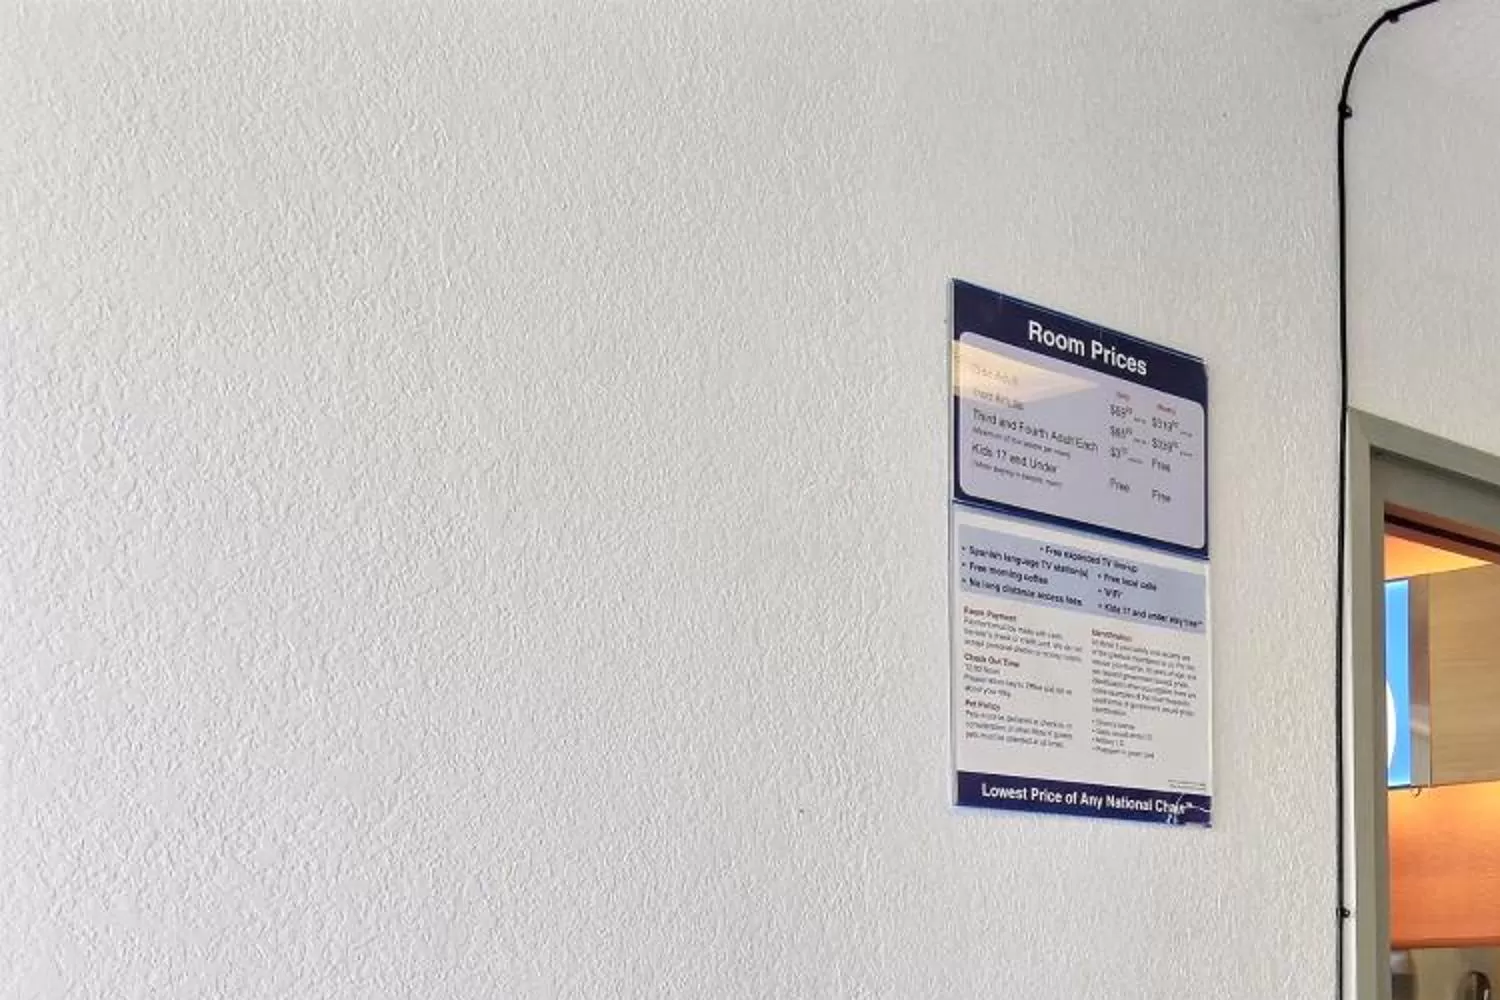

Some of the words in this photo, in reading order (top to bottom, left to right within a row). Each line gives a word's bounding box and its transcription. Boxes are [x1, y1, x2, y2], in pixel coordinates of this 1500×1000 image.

[1028, 319, 1085, 357] Room
[1091, 340, 1147, 375] Prices
[973, 408, 997, 425] Third
[999, 418, 1017, 431] and
[1019, 421, 1049, 439] Fourth
[972, 443, 992, 458] Kids
[1010, 454, 1027, 467] and
[1029, 456, 1057, 473] Under
[969, 545, 1002, 560] Spanish
[1003, 551, 1039, 568] language
[1041, 559, 1052, 570] TV
[1045, 545, 1062, 557] Free
[1101, 557, 1111, 567] TV
[969, 561, 987, 573] Free
[989, 567, 1022, 582] morning
[1023, 573, 1049, 585] coffee
[1103, 573, 1121, 584] Free
[1121, 577, 1138, 588] local
[1140, 581, 1157, 592] calls
[969, 577, 981, 588] No
[981, 581, 1000, 592] long
[1002, 584, 1035, 597] distance
[1037, 591, 1064, 603] access
[1103, 603, 1121, 614] Kids
[1132, 608, 1146, 618] and
[1147, 612, 1168, 622] under
[981, 783, 1028, 800] Lowest
[1031, 787, 1063, 803] Price
[1065, 791, 1078, 804] of
[1080, 791, 1103, 811] Any
[1105, 794, 1153, 811] National
